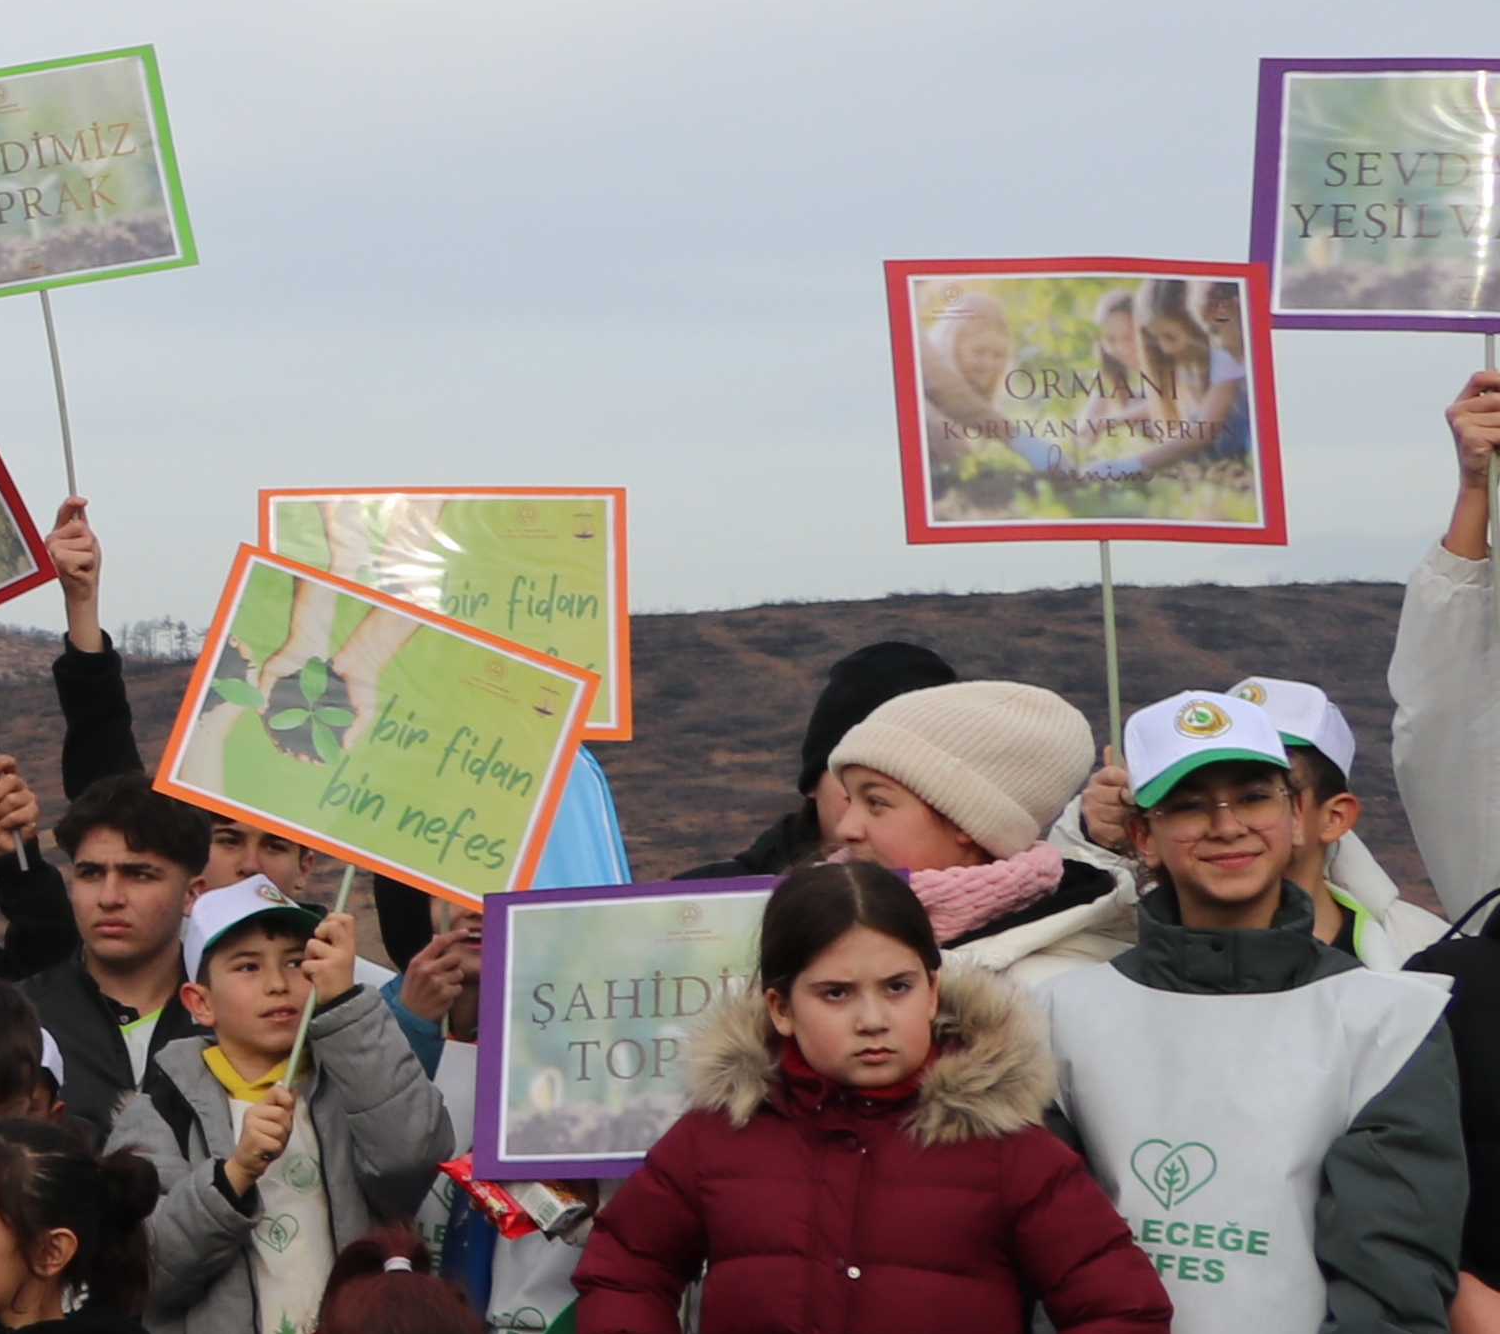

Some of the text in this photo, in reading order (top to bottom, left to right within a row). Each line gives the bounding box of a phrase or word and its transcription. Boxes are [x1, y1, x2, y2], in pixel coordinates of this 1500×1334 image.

[1004, 368, 1178, 401] ORMANI
[942, 419, 1080, 441] KORUYAN
[1046, 443, 1156, 484] benim
[505, 572, 598, 630] fidan
[368, 694, 534, 798] bir fidan
[318, 755, 507, 870] bin nefes
[566, 1037, 682, 1082] TOP
